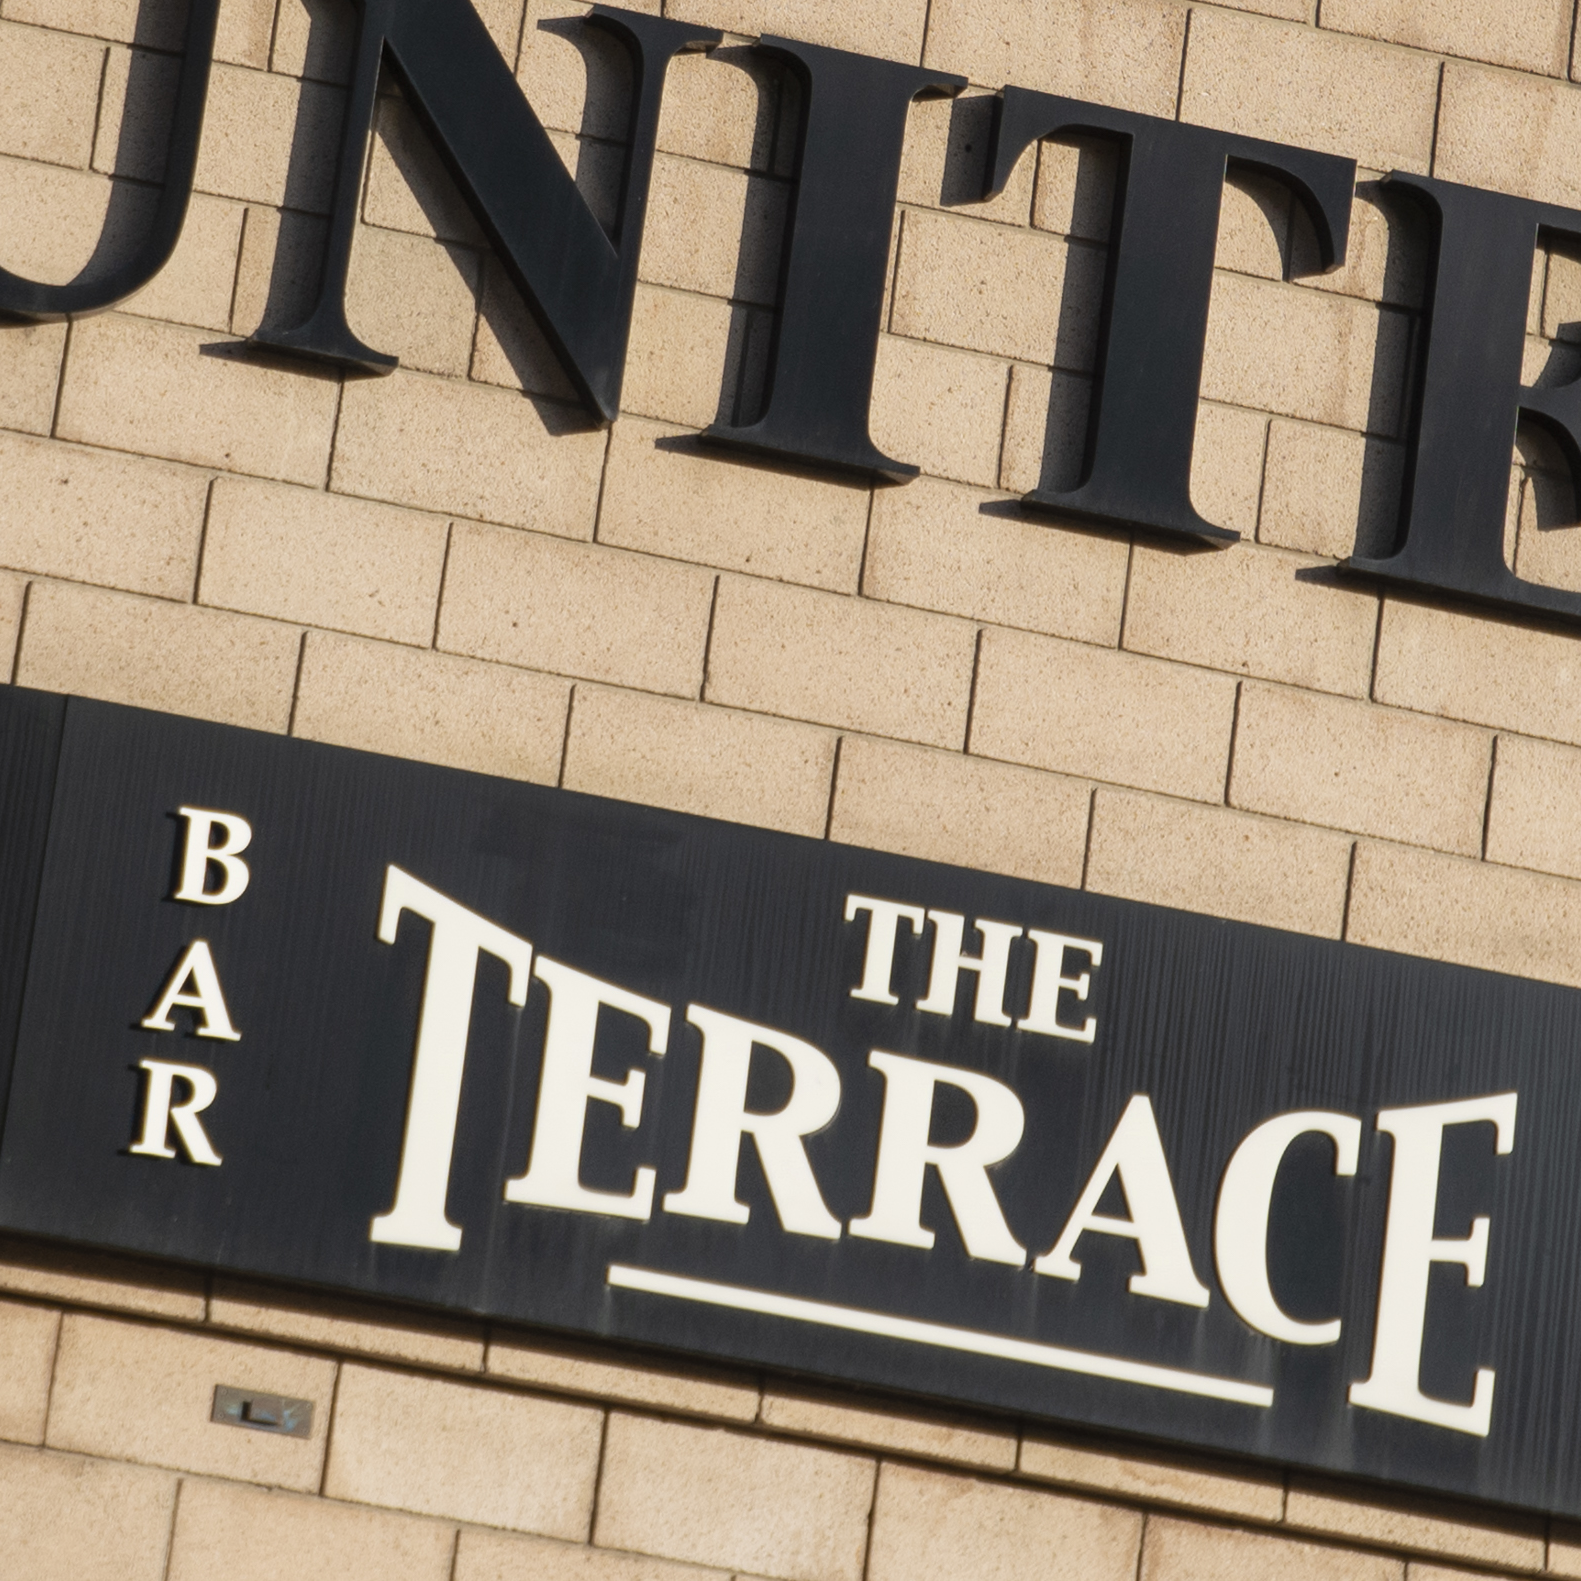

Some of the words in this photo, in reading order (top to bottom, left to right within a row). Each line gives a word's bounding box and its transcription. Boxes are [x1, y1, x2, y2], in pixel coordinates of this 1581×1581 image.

[129, 805, 253, 1167] BAR
[844, 893, 1105, 1045] THE
[369, 863, 1519, 1438] TERRACE
